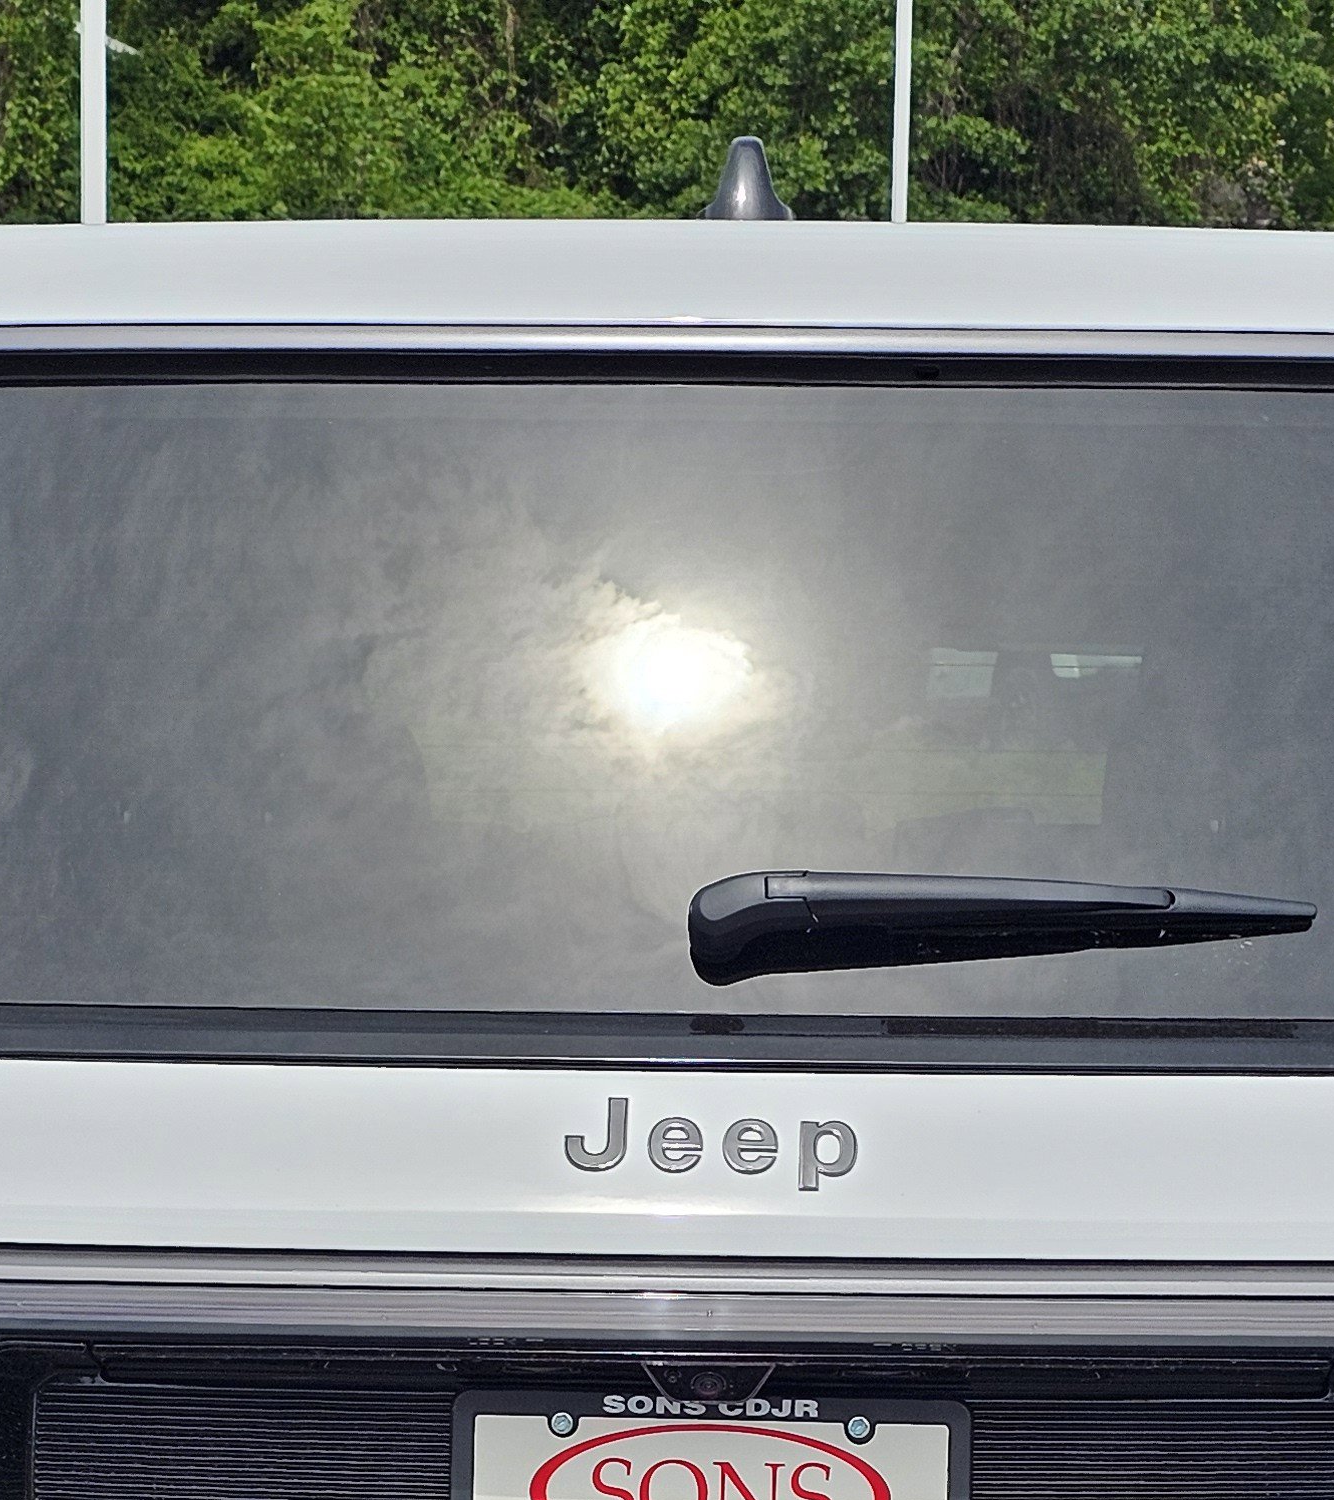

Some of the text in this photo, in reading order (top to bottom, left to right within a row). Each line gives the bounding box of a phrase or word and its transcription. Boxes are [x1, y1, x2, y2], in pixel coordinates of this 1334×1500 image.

[564, 1096, 858, 1192] Jeep
[603, 1395, 819, 1418] SONS CDJR
